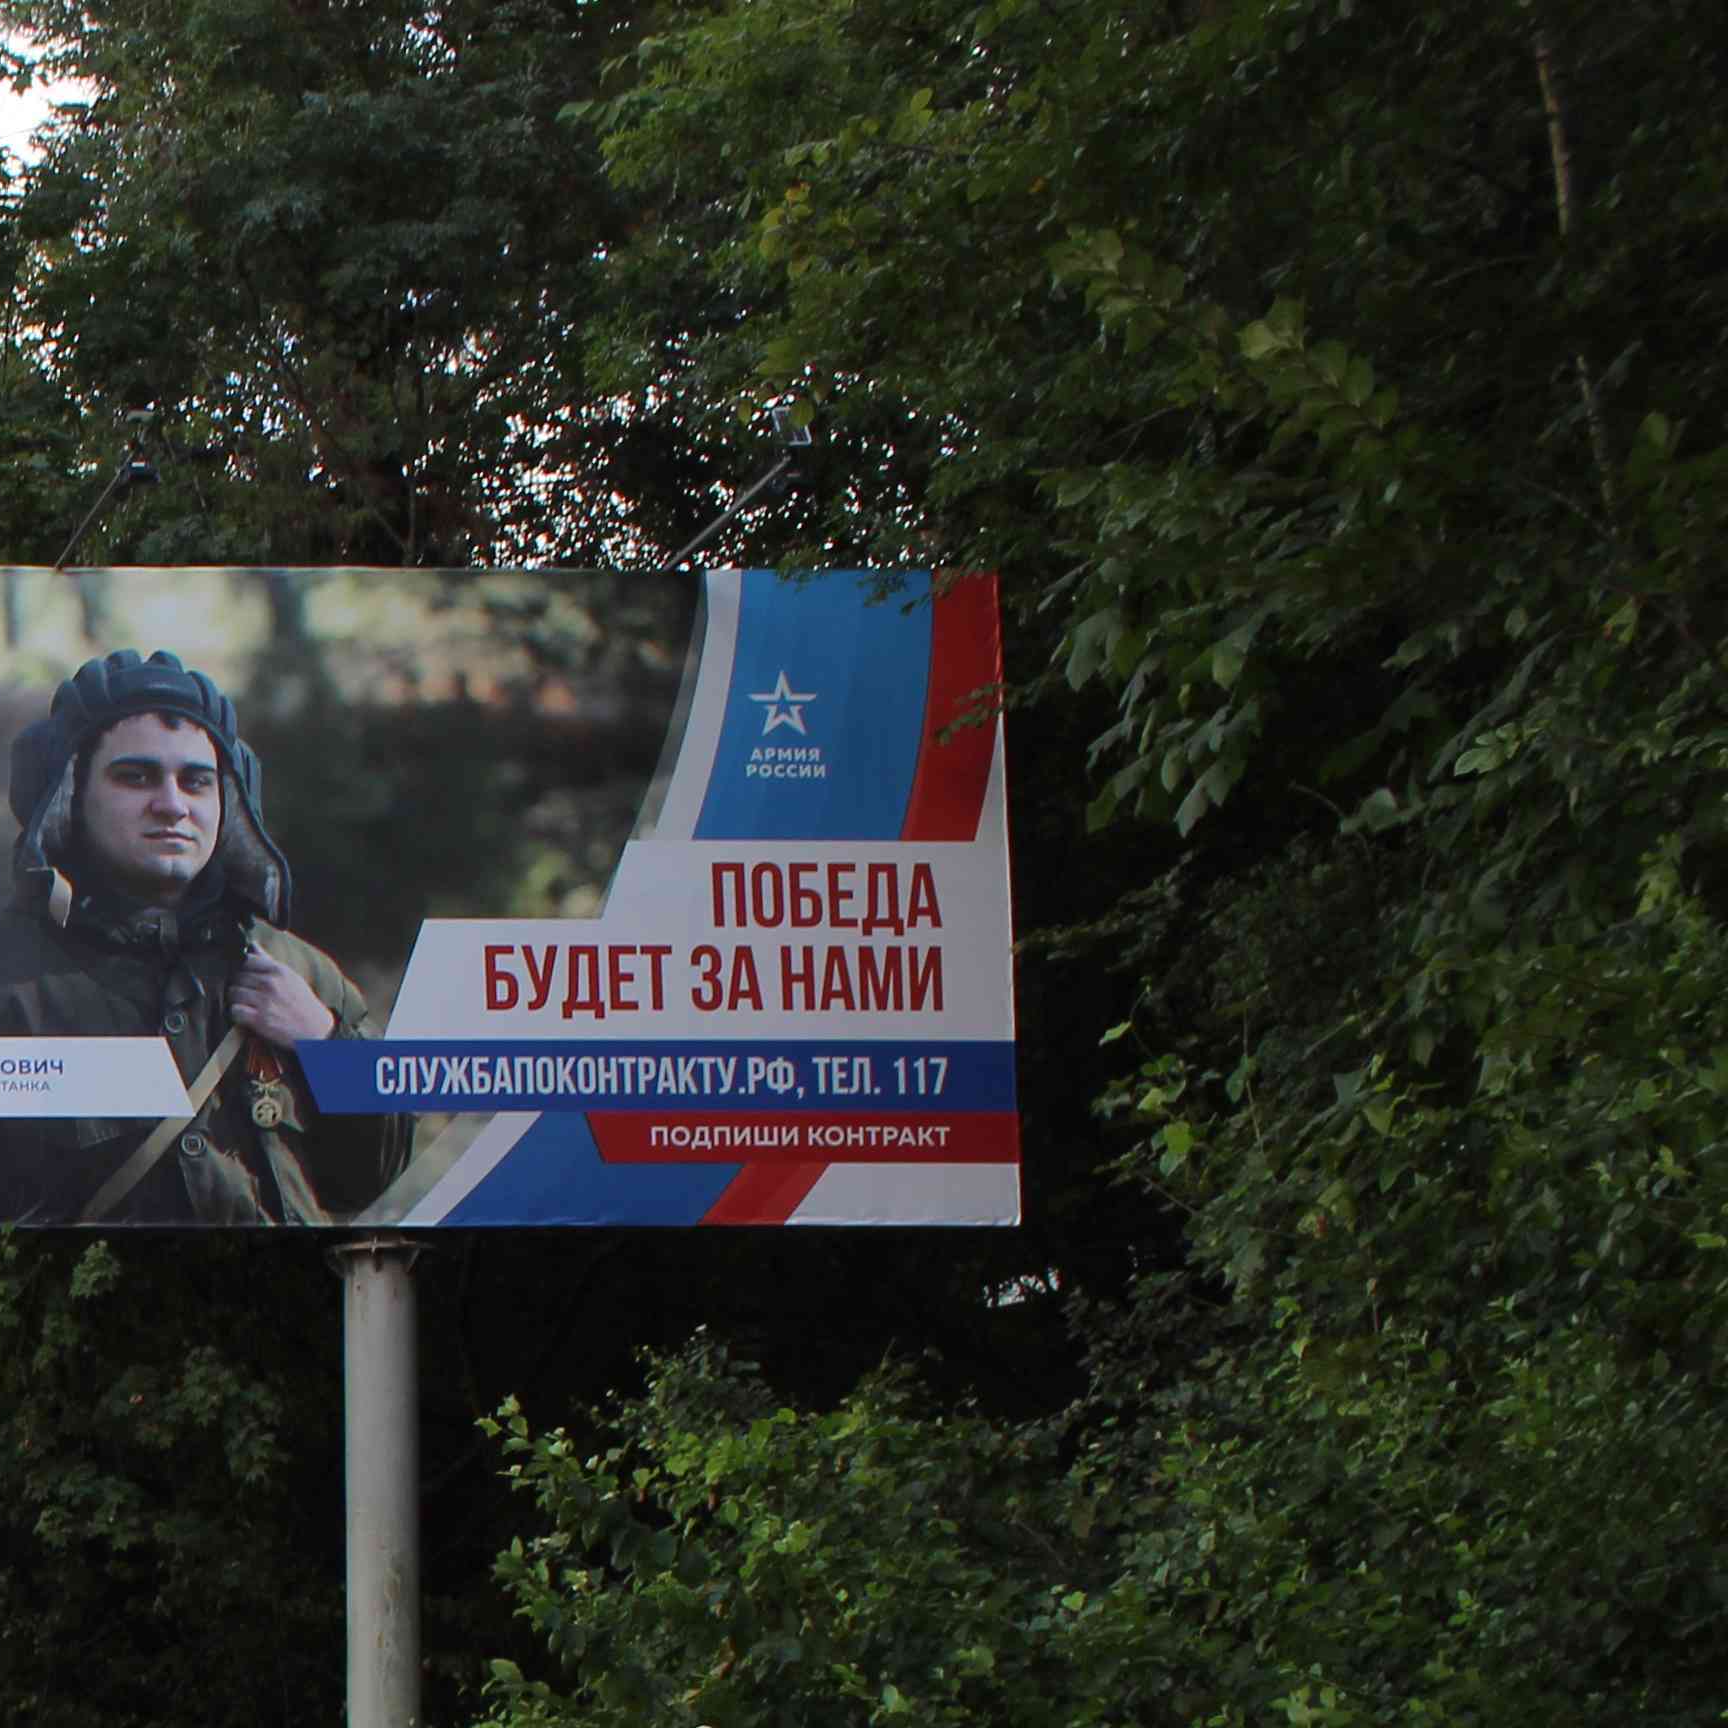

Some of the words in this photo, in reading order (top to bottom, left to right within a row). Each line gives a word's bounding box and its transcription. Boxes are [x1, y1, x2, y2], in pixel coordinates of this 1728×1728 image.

[750, 747, 820, 761] АРМИЯ
[745, 763, 826, 778] РОССИИ
[711, 861, 943, 937] ПОБЕДА
[484, 944, 673, 1020] БУДЕТ
[690, 944, 764, 1012] ЗА
[780, 945, 944, 1012] НАМИ
[1, 1079, 51, 1093] ТАНКА
[375, 1056, 804, 1099] СЛУЖБАПОКОНТРАКТУ.РФ,
[811, 1056, 881, 1095] ТЕЛ.
[893, 1057, 948, 1095] 117
[650, 1125, 799, 1150] ПОДПИШИ
[807, 1125, 951, 1147] КОНТРАКТ
